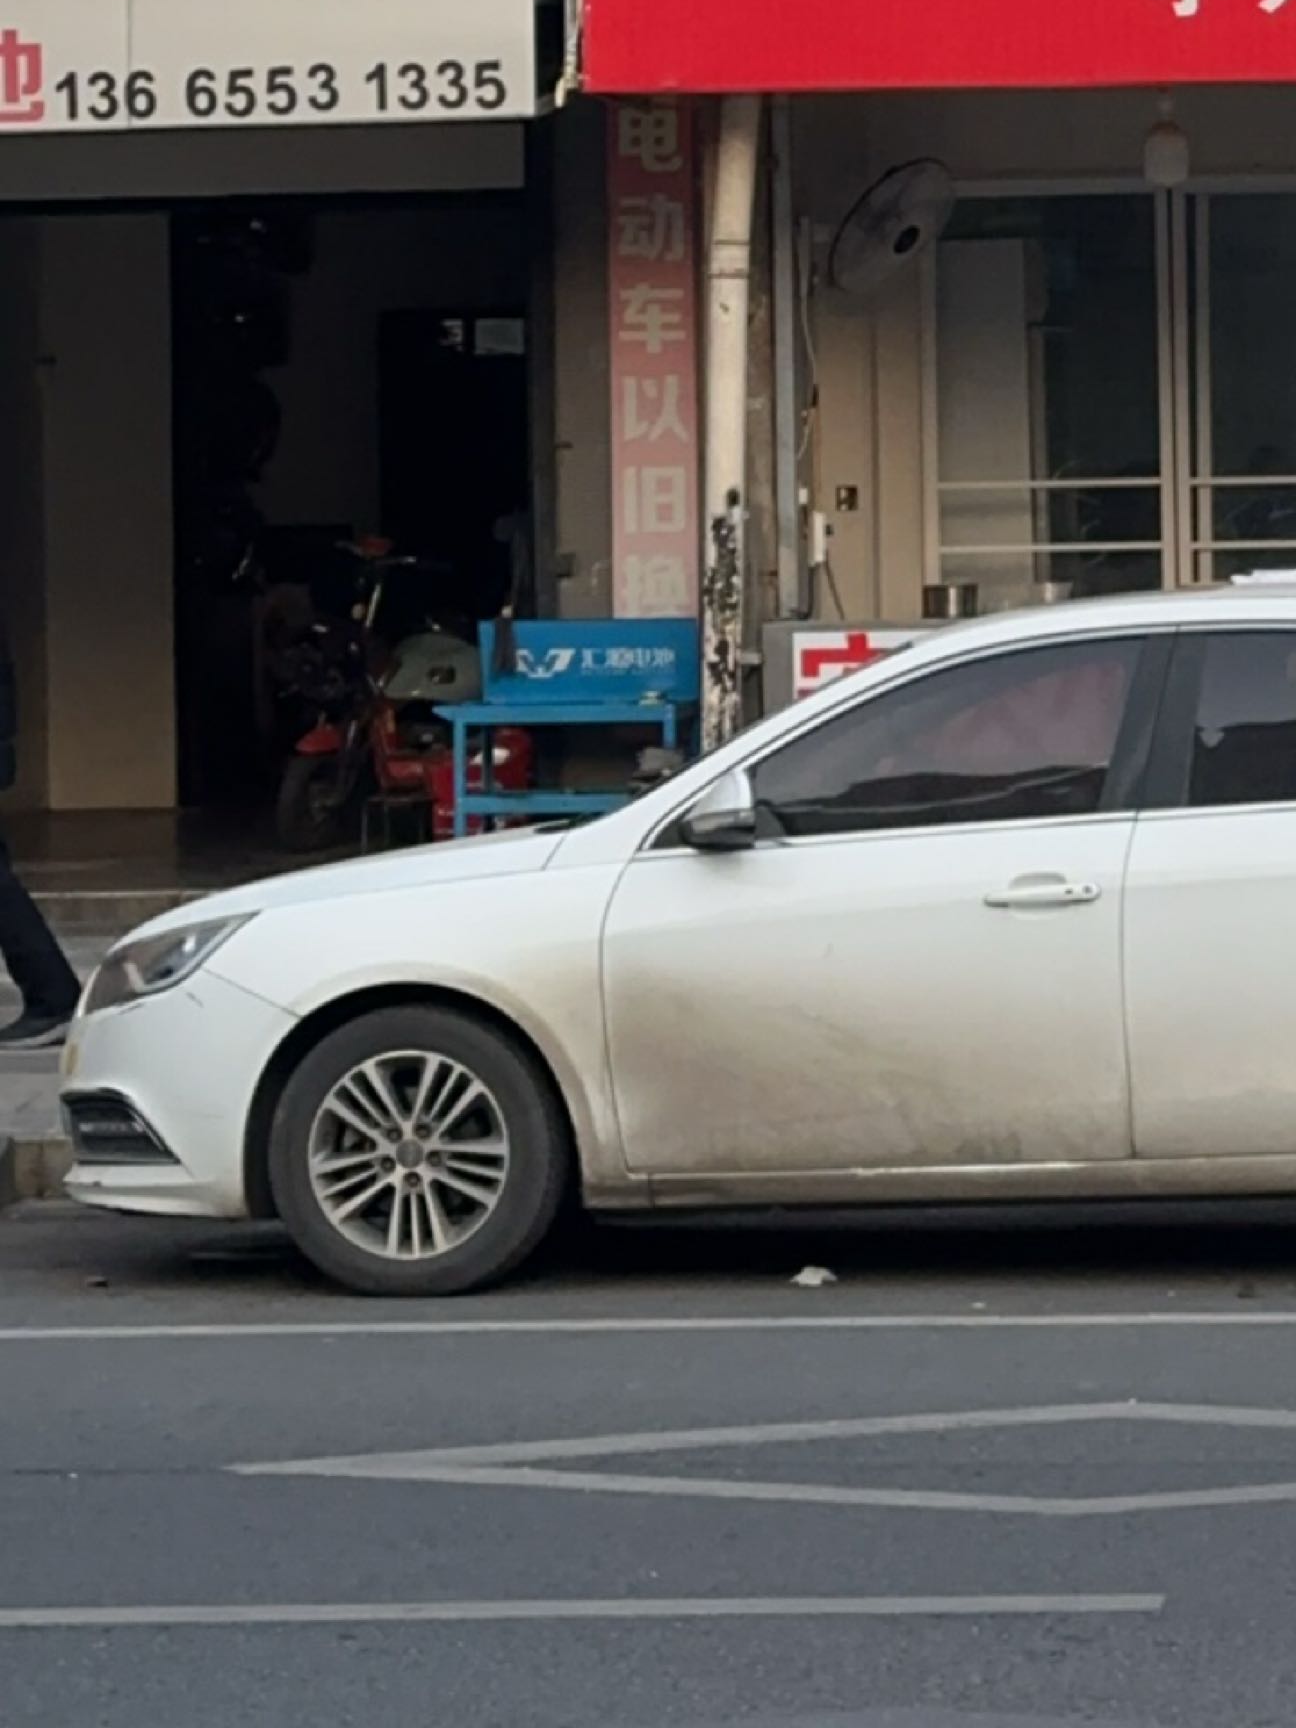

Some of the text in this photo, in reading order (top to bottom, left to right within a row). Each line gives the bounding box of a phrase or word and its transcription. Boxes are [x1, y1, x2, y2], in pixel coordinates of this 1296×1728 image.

[55, 69, 157, 121] 136
[186, 63, 340, 118] 6553
[365, 60, 507, 112] 1335
